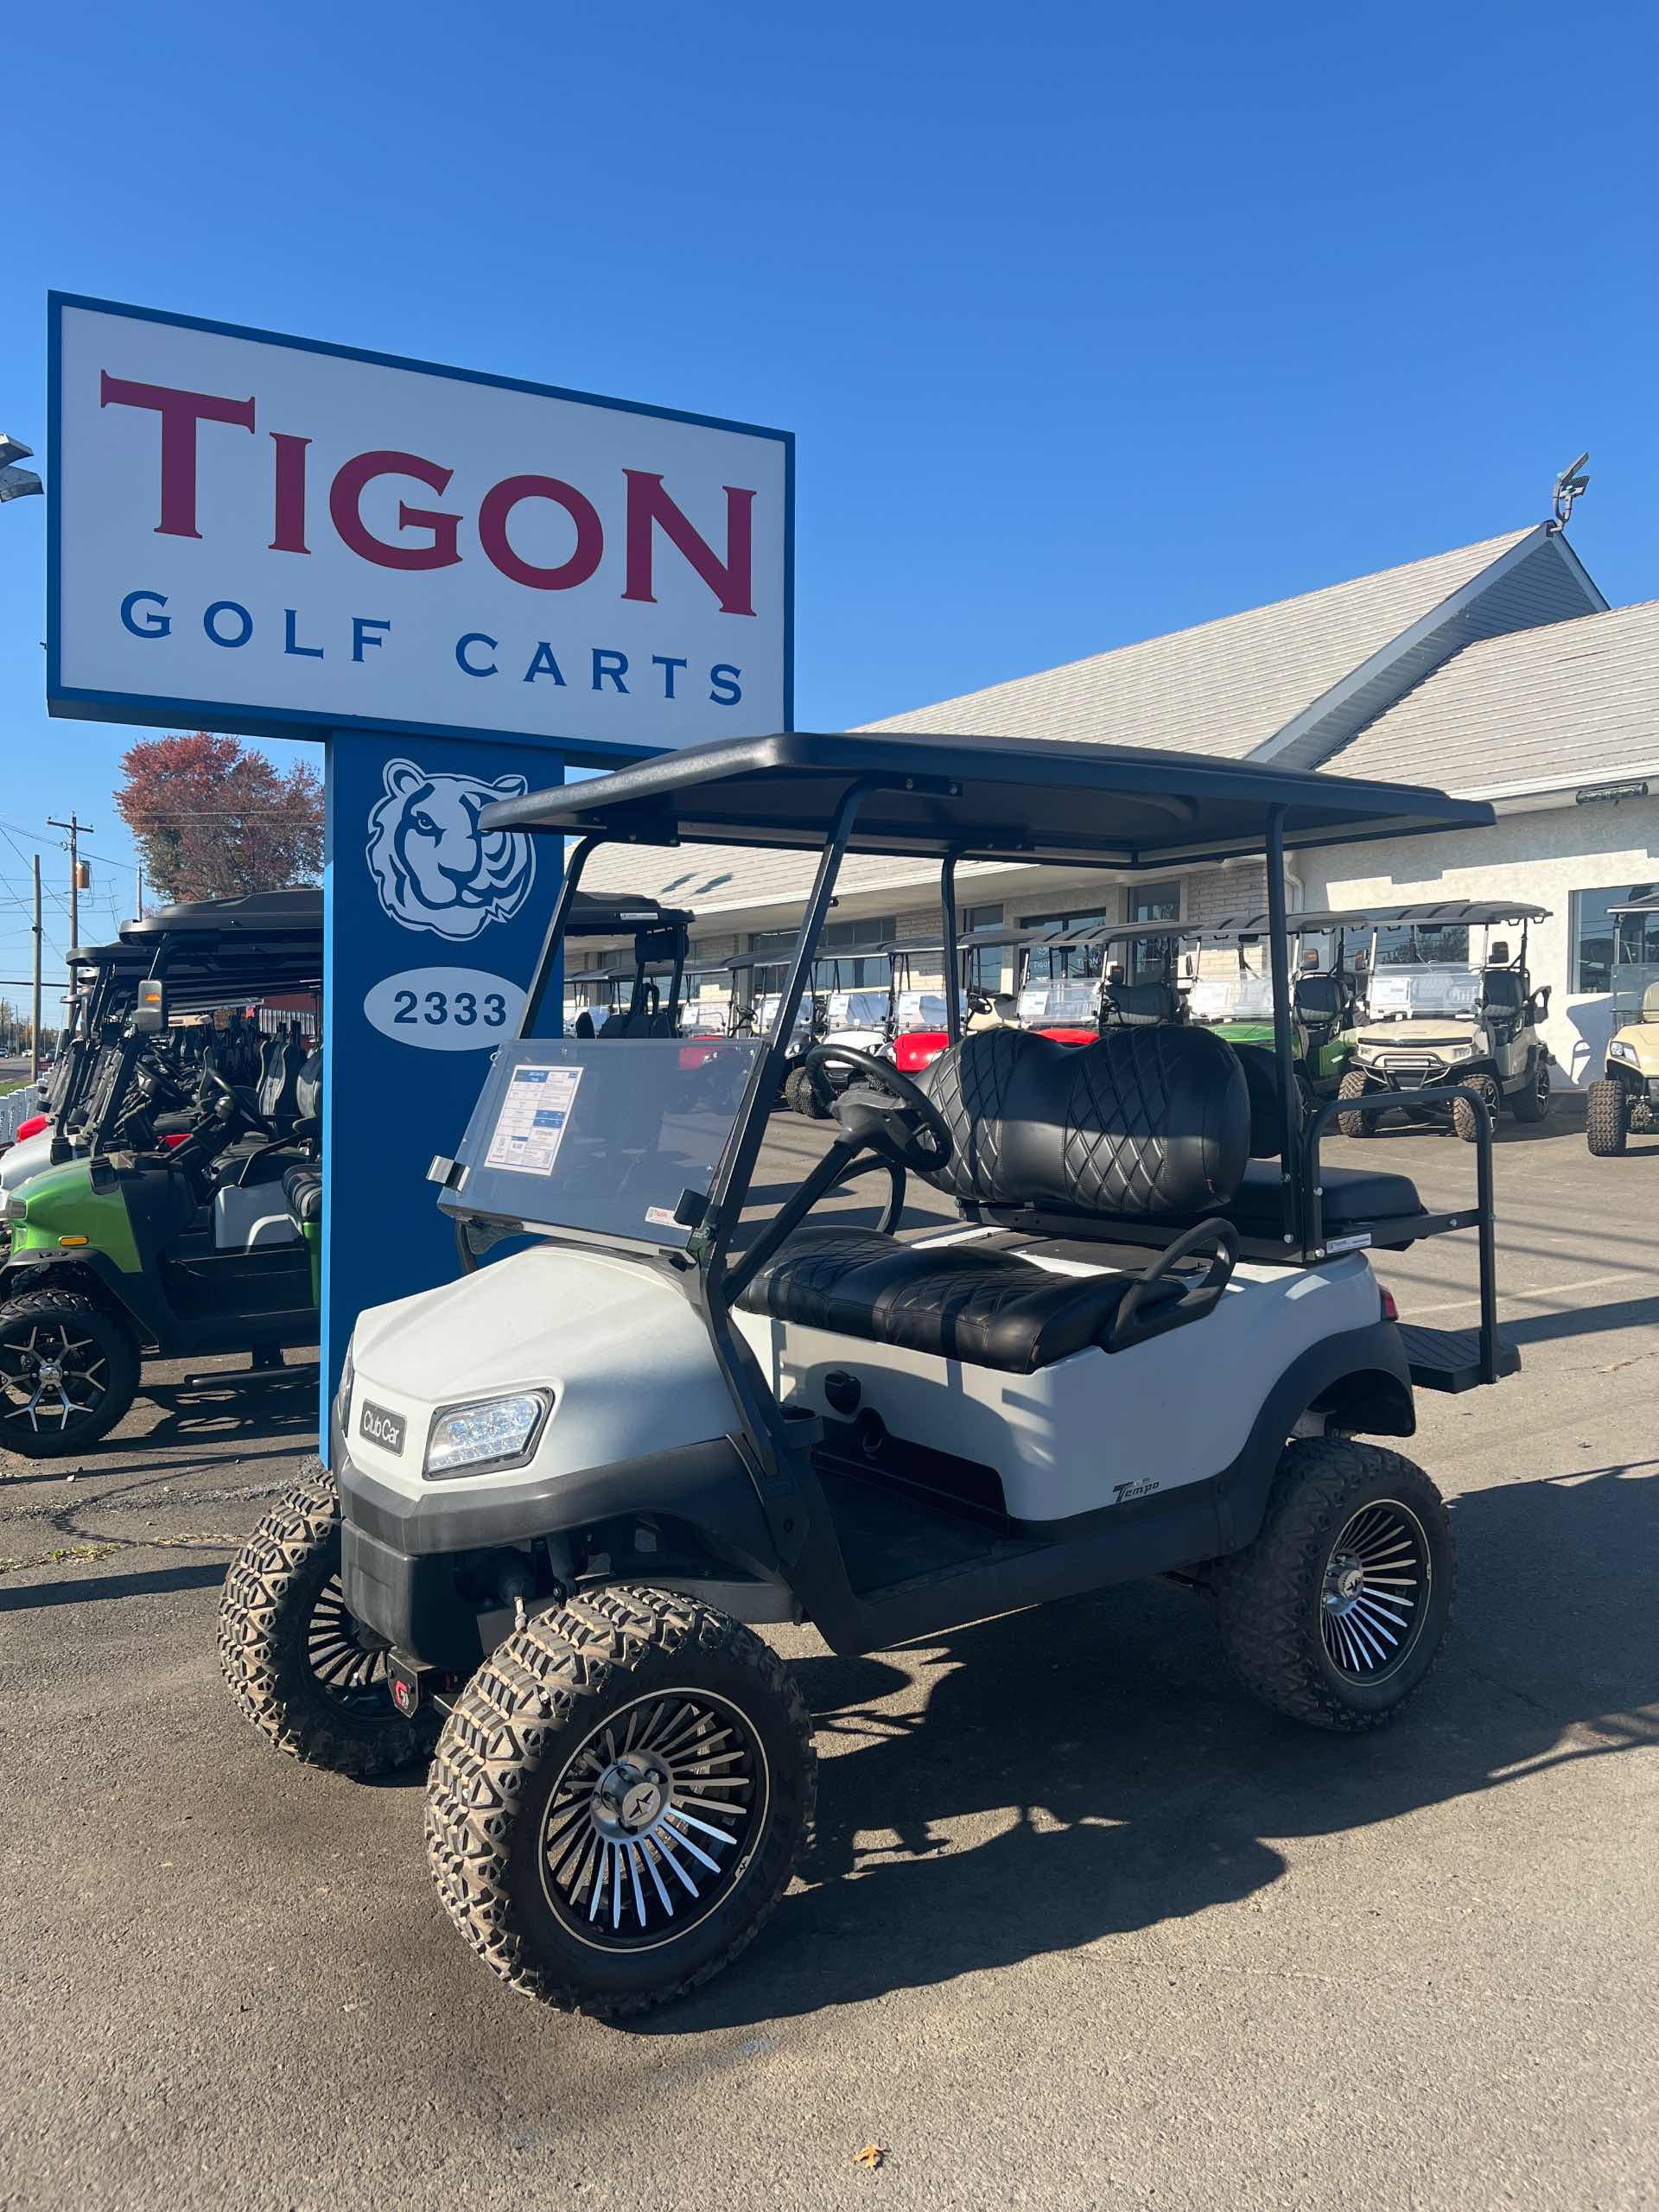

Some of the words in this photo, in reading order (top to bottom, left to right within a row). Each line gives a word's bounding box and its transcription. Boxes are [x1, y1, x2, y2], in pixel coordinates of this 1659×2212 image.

[100, 369, 757, 616] TIGON
[120, 590, 391, 663] GOLF
[455, 632, 743, 706] CARTS
[393, 990, 506, 1027] 2333
[1112, 1481, 1160, 1503] Tempo
